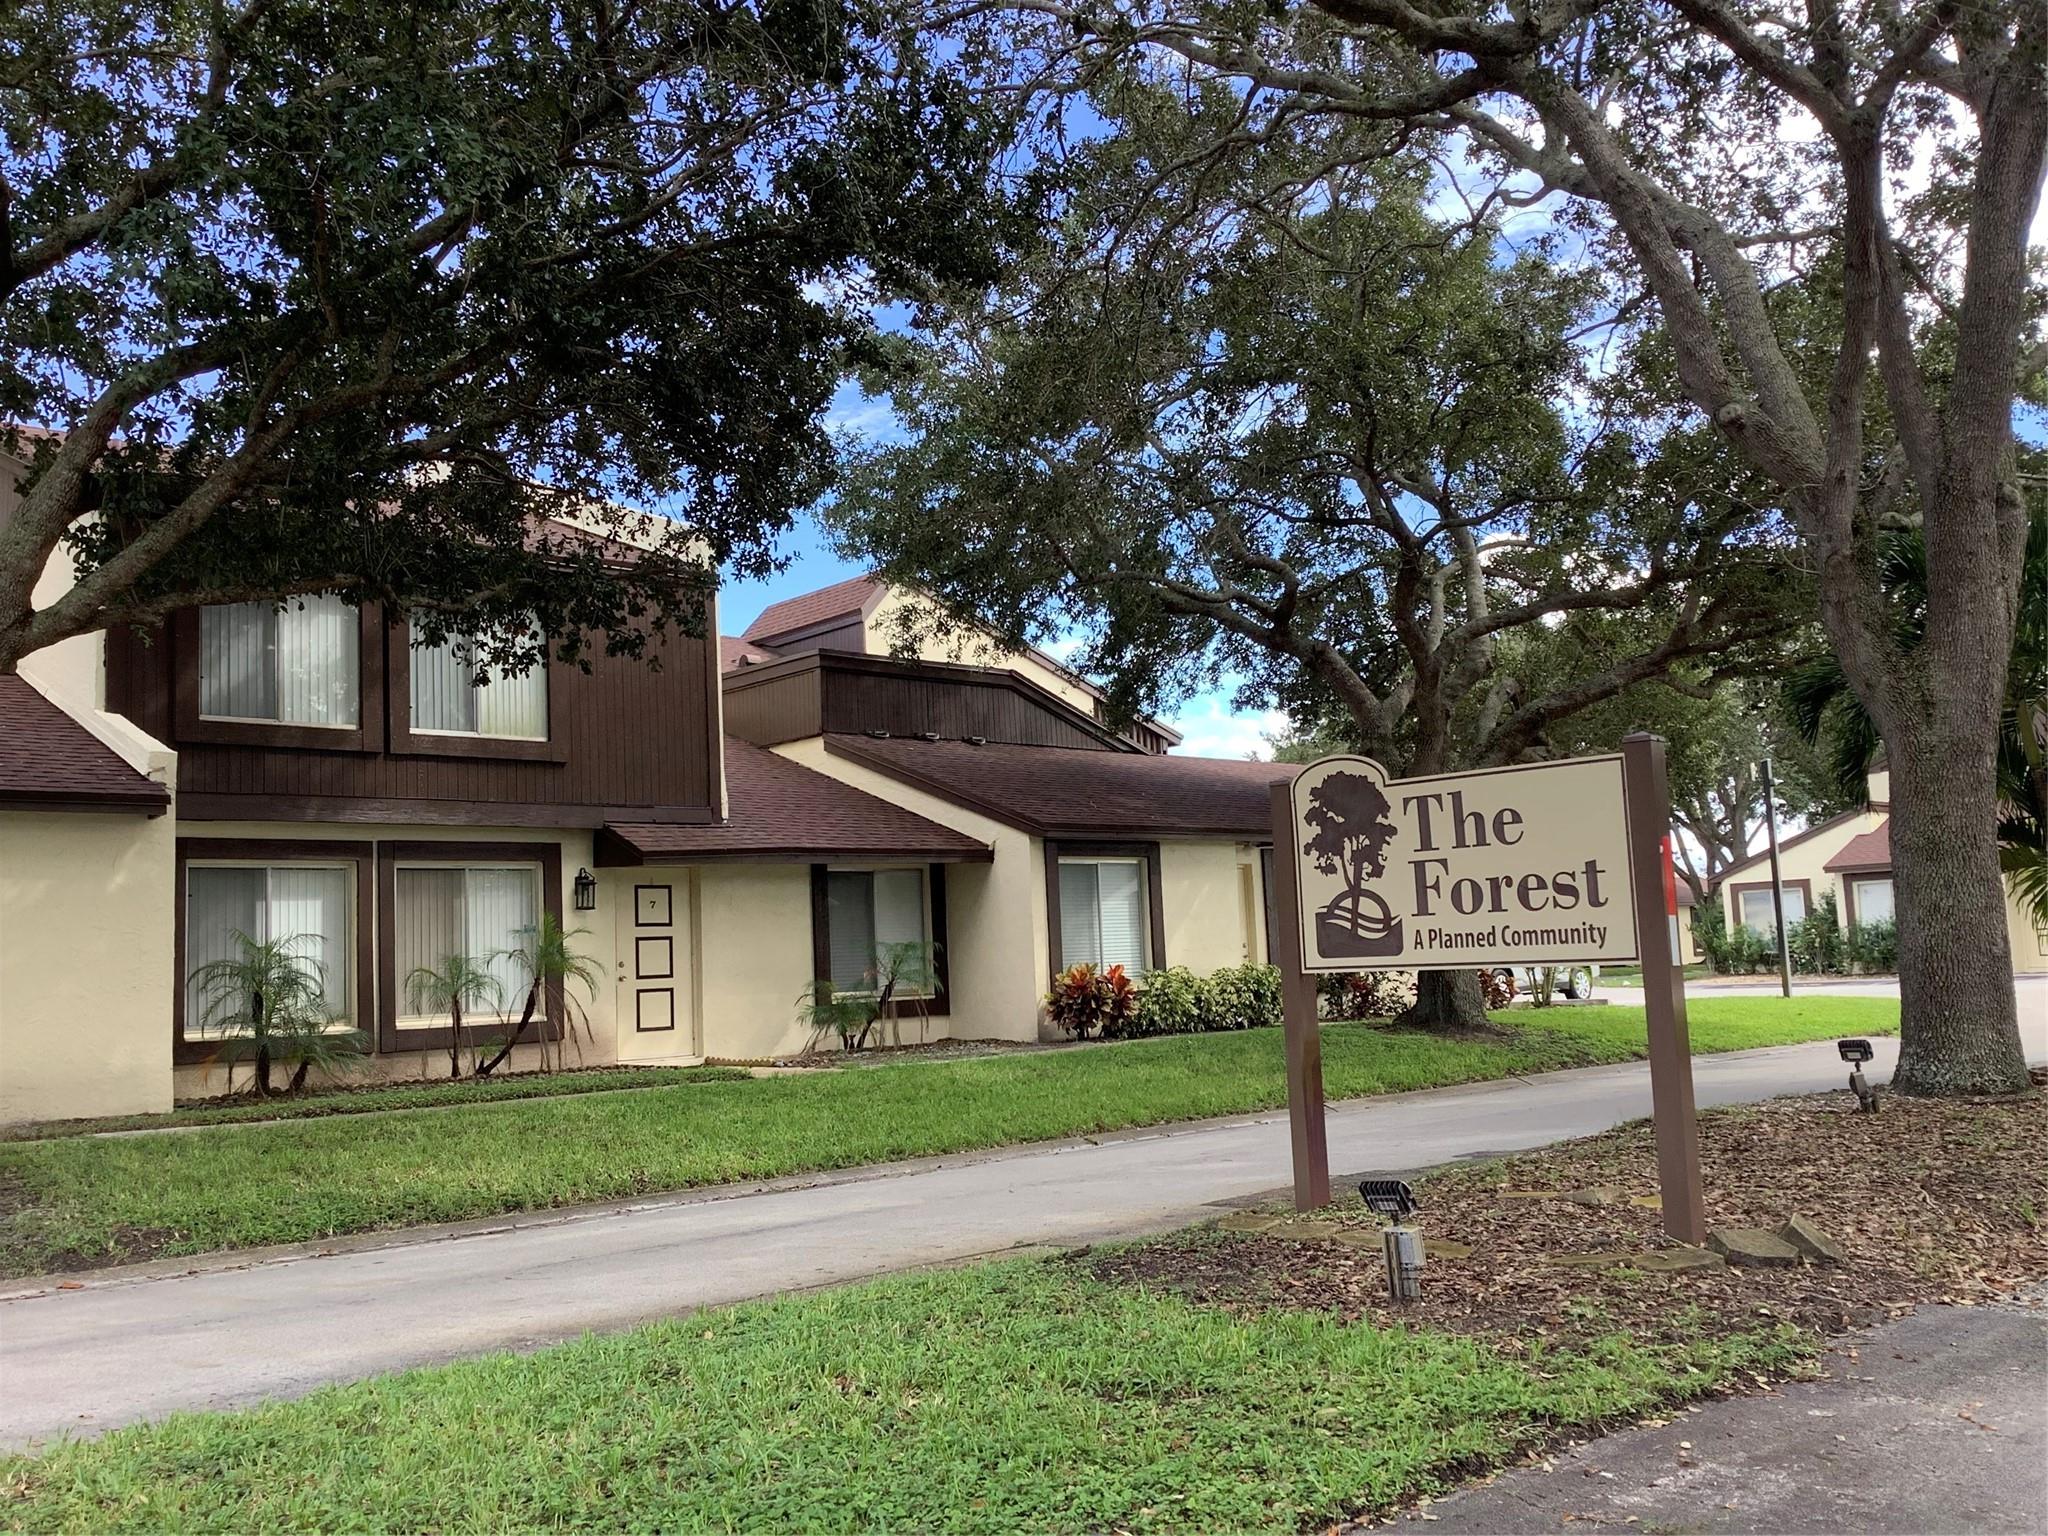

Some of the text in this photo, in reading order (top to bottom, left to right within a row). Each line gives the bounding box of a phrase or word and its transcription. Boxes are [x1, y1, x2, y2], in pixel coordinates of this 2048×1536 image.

[1402, 790, 1525, 852] The
[649, 900, 657, 909] 7
[1407, 858, 1609, 917] Forest
[1413, 921, 1607, 950] A Planned Community
